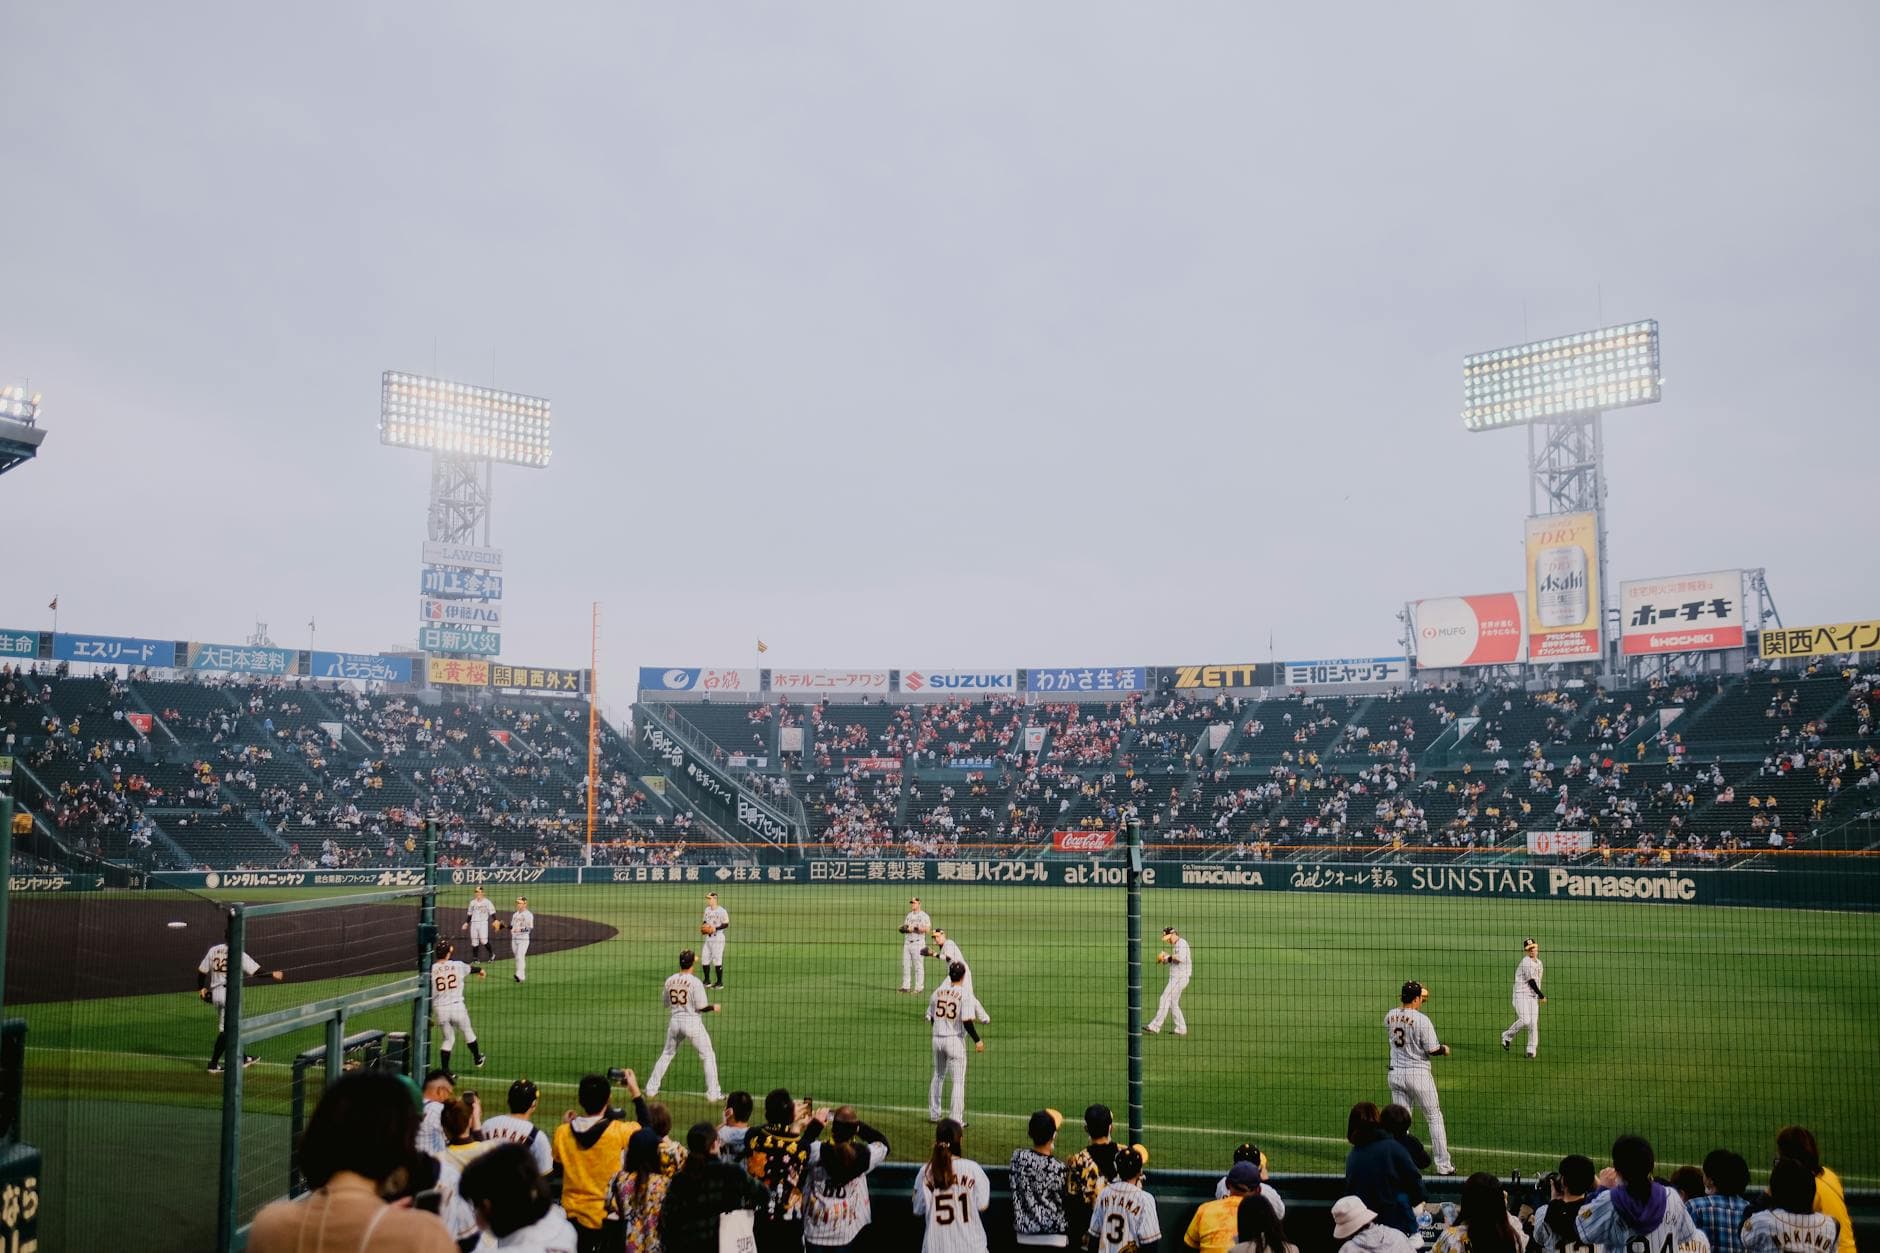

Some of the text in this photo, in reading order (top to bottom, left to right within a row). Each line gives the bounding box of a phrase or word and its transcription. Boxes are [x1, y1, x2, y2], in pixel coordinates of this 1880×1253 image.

[426, 572, 500, 597] 川上塗料
[1540, 569, 1583, 593] Asahi
[445, 605, 499, 622] 伊藤ハム
[1630, 598, 1733, 626] ホーチキ
[425, 630, 496, 651] 日新火災
[1438, 627, 1466, 636] MUFG
[1659, 633, 1714, 647] HOCHIKI
[73, 641, 156, 662] エスリード
[201, 647, 285, 672] 大日本塗料
[346, 662, 398, 680] ろうきん
[443, 661, 487, 684] 黄桜
[513, 668, 577, 690] 関西外大
[704, 671, 740, 689] 白鶴
[774, 673, 887, 688] ホテルニューアワジ
[929, 674, 1012, 688] SUZUKI
[1037, 669, 1137, 690] わかさ生活
[1175, 664, 1256, 688] ZETT
[643, 721, 683, 767] 大同生命
[223, 873, 305, 886] レンタルのニッケン
[377, 869, 425, 886] オービッ
[466, 868, 546, 883] 日本ハウズイング
[733, 866, 796, 881] 住友電工
[810, 861, 925, 880] 田辺三菱製薬
[937, 861, 1048, 881] 東進ハイスクール
[1412, 867, 1536, 893] SUNSTAR
[1550, 870, 1697, 900] Panasonic
[435, 974, 458, 992] 62
[669, 989, 687, 1005] 63
[935, 1000, 957, 1019] 53
[1393, 1027, 1405, 1048] 3
[935, 1193, 969, 1225] 51
[1106, 1213, 1125, 1244] 3
[1772, 1230, 1832, 1251] NAKANO
